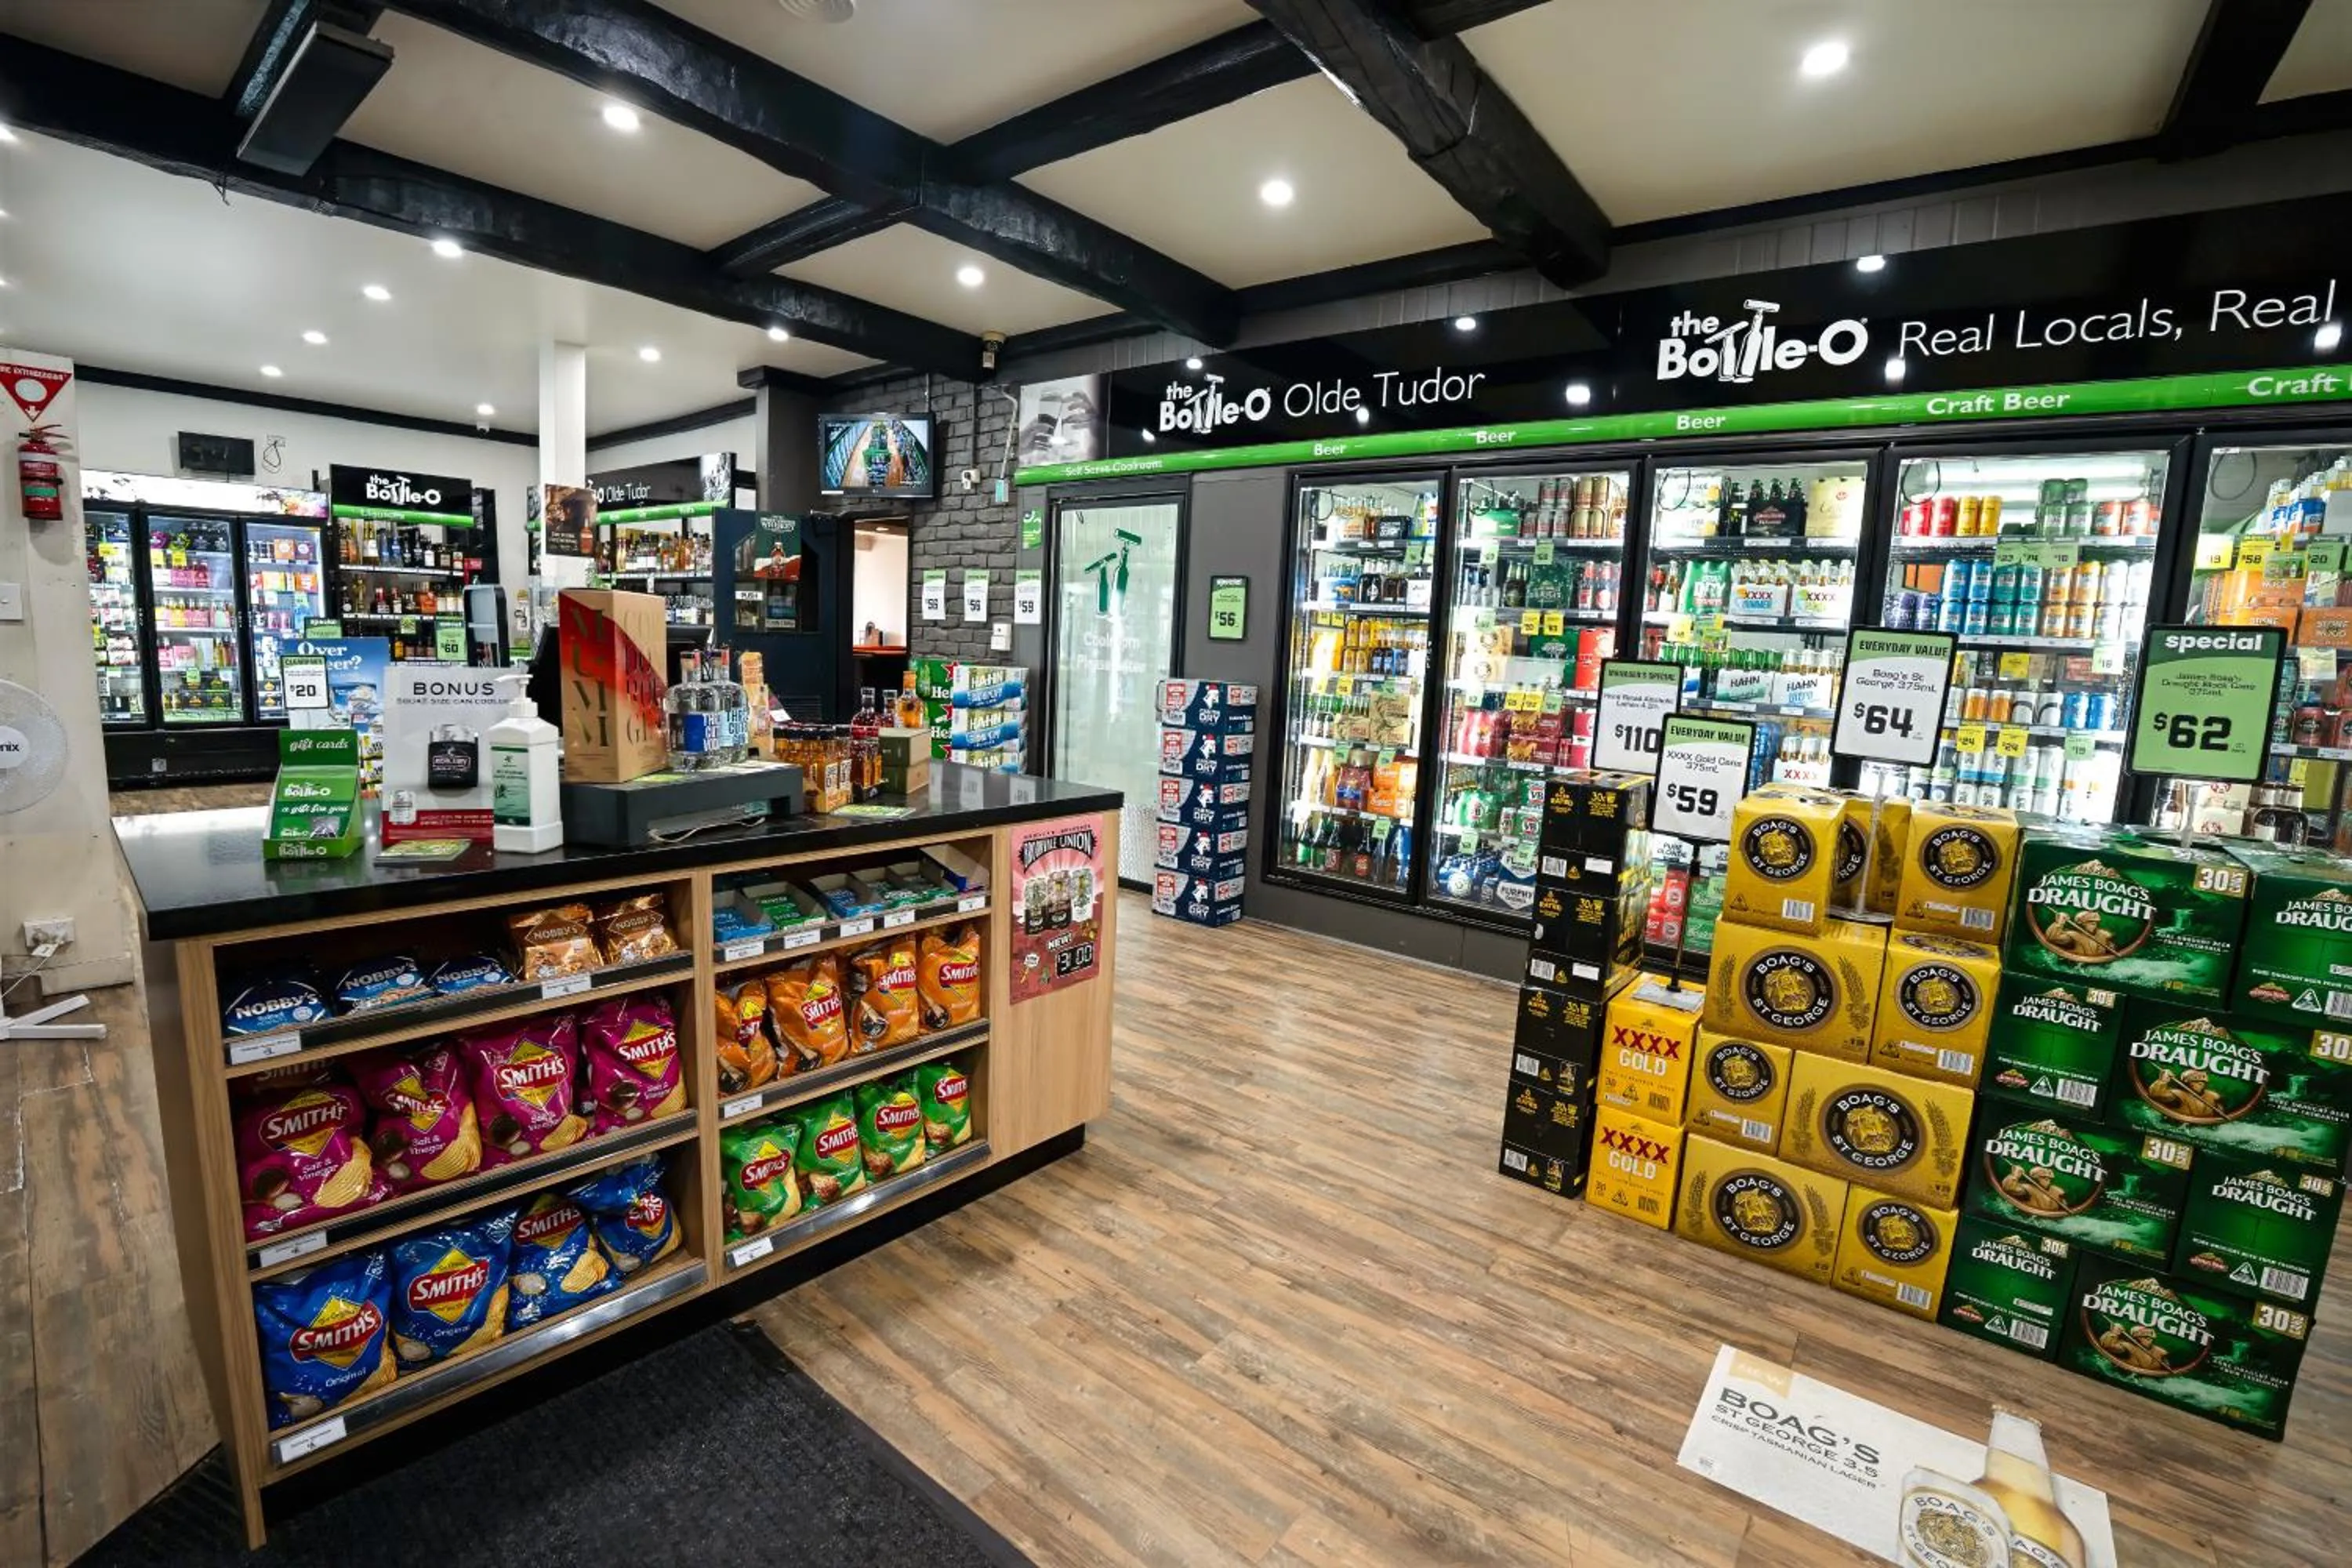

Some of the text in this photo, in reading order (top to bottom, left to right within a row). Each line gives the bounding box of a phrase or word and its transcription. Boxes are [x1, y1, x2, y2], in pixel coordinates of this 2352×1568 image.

[1671, 310, 1719, 337] the
[1899, 278, 2336, 358] Real Locals, Real
[1166, 381, 1192, 401] the
[1284, 367, 1486, 416] Olde Tudor
[2247, 372, 2339, 397] Craft
[1926, 391, 2071, 416] Craft Beer
[1677, 413, 1726, 431] Beer
[1313, 442, 1347, 457] Beer
[1476, 429, 1517, 445] Beer
[370, 474, 389, 486] the
[606, 485, 625, 503] Olde
[626, 483, 652, 500] Tudor
[298, 642, 347, 656] Over
[1859, 640, 1949, 657] EVERYDAY VALUE
[2165, 632, 2263, 654] special
[414, 682, 495, 695] BONUS
[971, 667, 1004, 688] HAHN
[1730, 676, 1760, 687] HAHN
[1787, 679, 1818, 691] HAHN
[290, 684, 317, 698] $20
[970, 707, 1002, 729] HAHN
[1853, 702, 1914, 738] $64
[1615, 724, 1661, 753] $110
[1671, 725, 1746, 743] EVERYDAY VALUE
[2153, 712, 2232, 751] $62
[1666, 750, 1693, 761] XXXX
[1695, 753, 1716, 764] Gold
[1666, 783, 1719, 816] $59
[1752, 821, 1798, 837] BOAG'S
[1933, 830, 1980, 846] BOAG'S
[1058, 829, 1092, 858] UNION
[1766, 853, 1808, 877] GEORGE
[1944, 861, 1993, 884] GEORGE
[2039, 874, 2151, 902] JAMES BOAG'S
[2199, 868, 2229, 891] 30
[2027, 887, 2157, 920] DRAUGHT
[2287, 901, 2331, 912] JAMES
[1755, 954, 1815, 975] BOAG'S
[1910, 969, 1960, 985] BOAG'S
[235, 992, 320, 1019] NOBBY'S
[1772, 997, 1828, 1026] GEORGE
[1921, 1002, 1972, 1025] GEORGE
[2022, 996, 2098, 1018] JAMES BOAG'S
[2013, 1004, 2102, 1033] DRAUGHT
[618, 1029, 677, 1061] SMITH'S
[1613, 1025, 1682, 1059] XXXX
[1717, 1046, 1758, 1062] BOAG'S
[2143, 1029, 2264, 1065] JAMES BOAG'S
[2317, 1034, 2350, 1059] 30
[500, 1056, 566, 1089] SMITH'S
[1619, 1048, 1668, 1077] GOLD
[2129, 1042, 2270, 1084] DRAUGHT
[1727, 1078, 1769, 1098] GEORGE
[1837, 1094, 1900, 1116] BOAG'S
[265, 1102, 349, 1141] SMITH'S
[409, 1142, 445, 1156] Vinegar
[412, 1138, 432, 1148] Salt
[1601, 1127, 1670, 1164] XXXX
[1852, 1140, 1914, 1167] GEORGE
[1999, 1128, 2103, 1164] JAMES BOAG'S
[2147, 1138, 2175, 1163] 30
[298, 1165, 338, 1182] Vinegar
[302, 1160, 322, 1174] Salt
[1609, 1150, 1656, 1180] GOLD
[1985, 1139, 2107, 1183] DRAUGHT
[1726, 1179, 1783, 1198] BOAG'S
[2223, 1176, 2311, 1207] JAMES BOAG'S
[1871, 1206, 1920, 1223] BOAG'S
[2211, 1185, 2317, 1221] DRAUGHT
[517, 1206, 581, 1238] SMITH'S
[1740, 1221, 1795, 1247] GEORGE
[1882, 1241, 1931, 1260] GEORGE
[1980, 1240, 2052, 1267] JAMES BOAG'S
[1972, 1247, 2056, 1280] DRAUGHT
[413, 1265, 490, 1300] SMITH'S
[2096, 1283, 2208, 1327] JAMES BOAG'S
[296, 1309, 379, 1351] SMITH'S
[2082, 1294, 2215, 1346] DRAUGHT
[2259, 1305, 2288, 1331] 30
[433, 1324, 470, 1339] Original
[325, 1367, 367, 1388] Original
[1719, 1387, 1880, 1465] BOAG'S
[1711, 1414, 1876, 1490] CRISP TASMANIAN LAGER
[1715, 1404, 1878, 1478] ST GEORGE 3.5
[1915, 1497, 1996, 1537] BOAG'S
